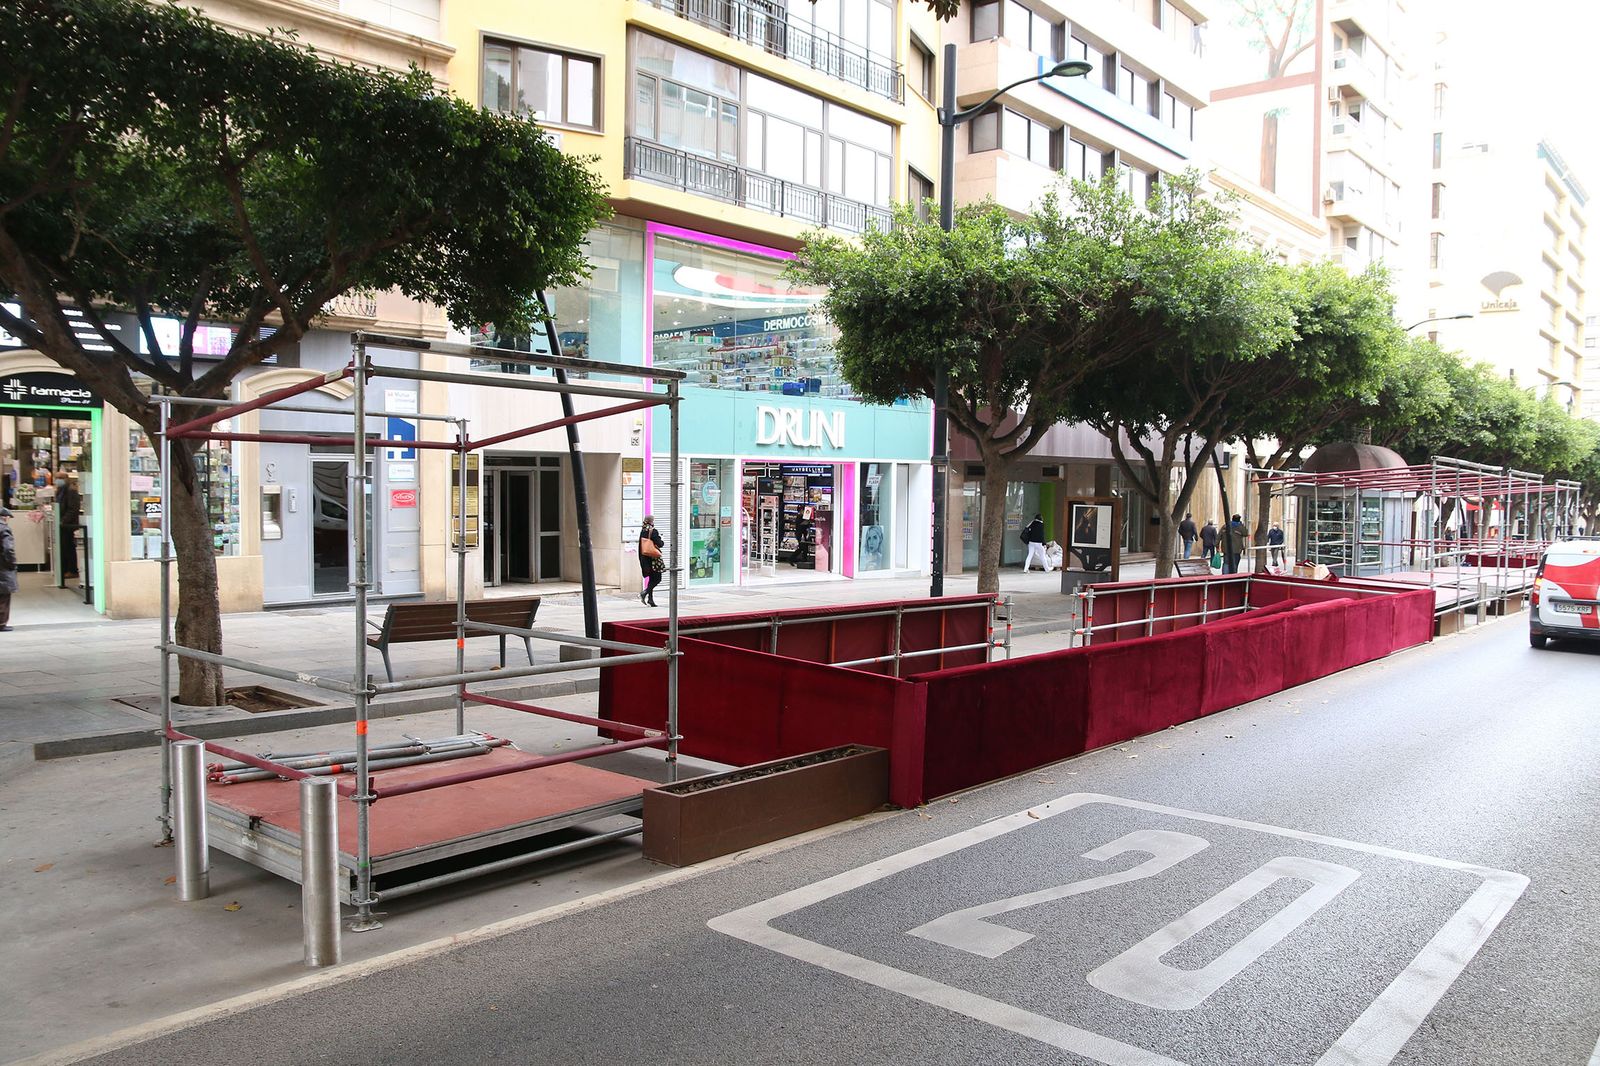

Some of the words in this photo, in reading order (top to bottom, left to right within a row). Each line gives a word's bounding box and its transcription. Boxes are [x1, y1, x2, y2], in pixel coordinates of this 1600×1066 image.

[1481, 298, 1517, 311] Unicaja
[31, 386, 92, 398] farmacia
[756, 405, 845, 450] DRUNI
[905, 830, 1363, 1010] 20
